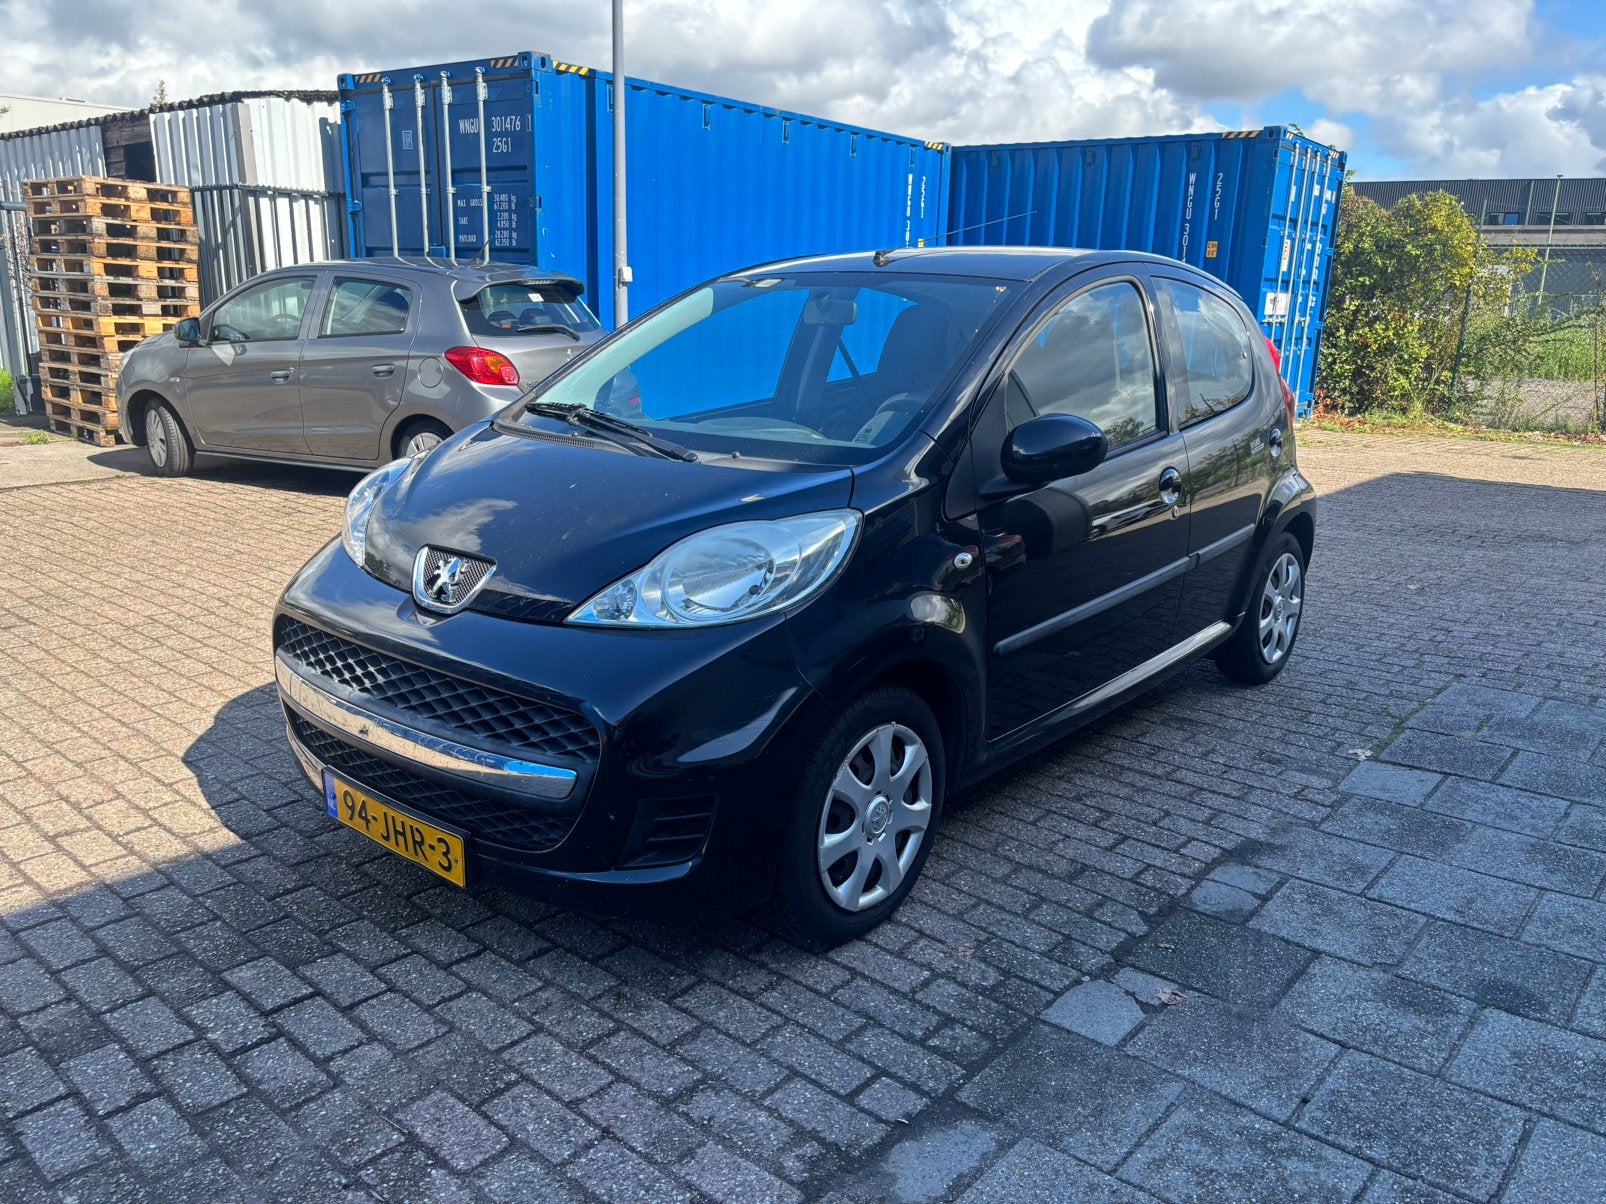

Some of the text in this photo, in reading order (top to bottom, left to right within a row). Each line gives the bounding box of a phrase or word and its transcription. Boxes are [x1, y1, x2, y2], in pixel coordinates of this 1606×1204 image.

[459, 118, 478, 134] WNGU
[491, 115, 521, 132] 301476
[492, 137, 511, 153] 25G1
[1186, 172, 1196, 220] WNGU
[1214, 172, 1224, 220] 25G1
[342, 789, 453, 873] 94-JHR-3
